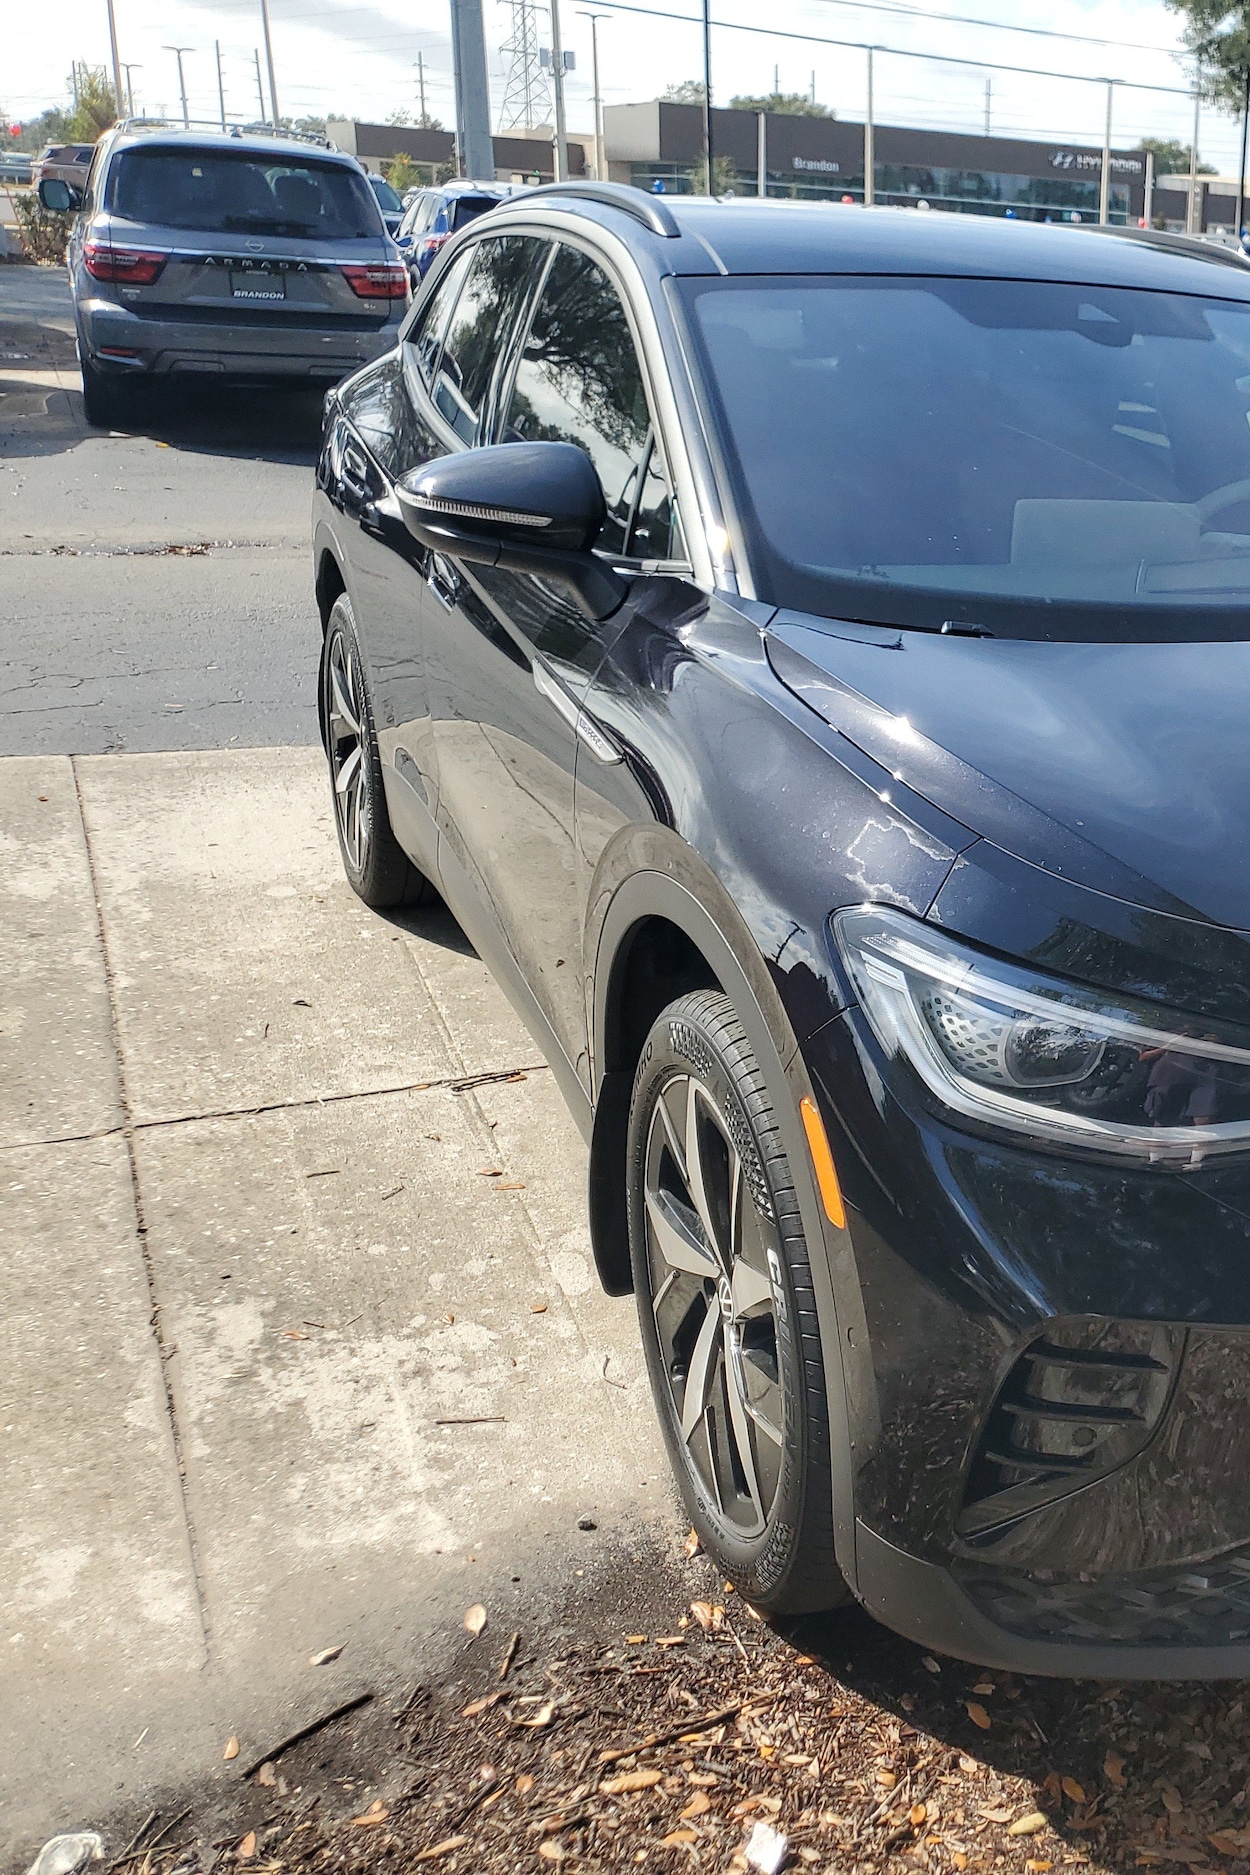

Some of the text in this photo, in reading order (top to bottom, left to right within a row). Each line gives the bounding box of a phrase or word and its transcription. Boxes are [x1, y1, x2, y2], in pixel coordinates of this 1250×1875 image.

[792, 157, 840, 171] Brandon
[1076, 153, 1142, 174] HYUDAI
[204, 256, 308, 271] ARMADA
[233, 290, 285, 300] BRANDON
